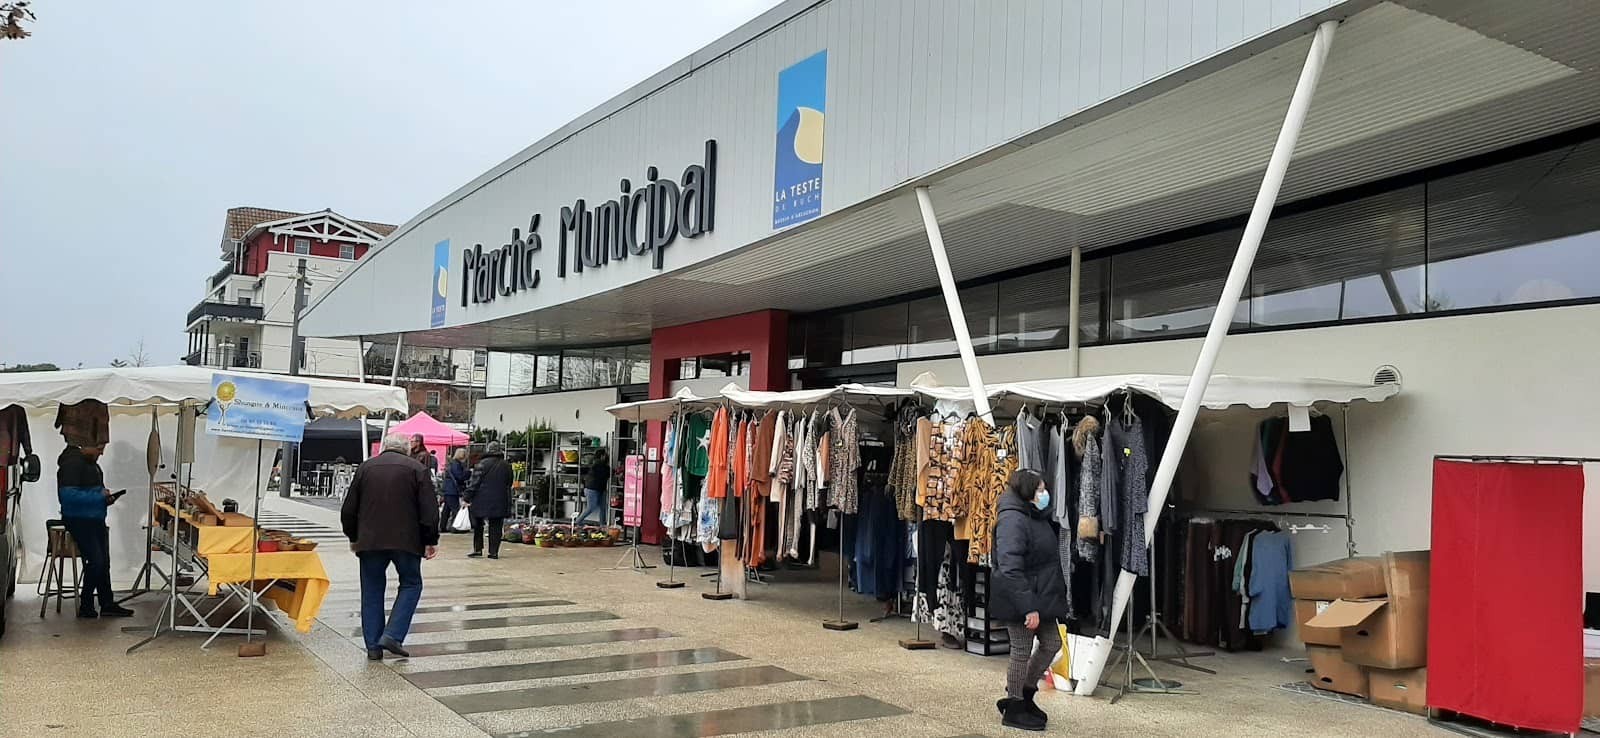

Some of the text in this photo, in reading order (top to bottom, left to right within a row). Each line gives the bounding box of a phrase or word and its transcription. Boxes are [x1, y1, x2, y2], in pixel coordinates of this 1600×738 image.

[460, 139, 717, 307] Marché Municipal
[775, 177, 820, 202] LA TESTE
